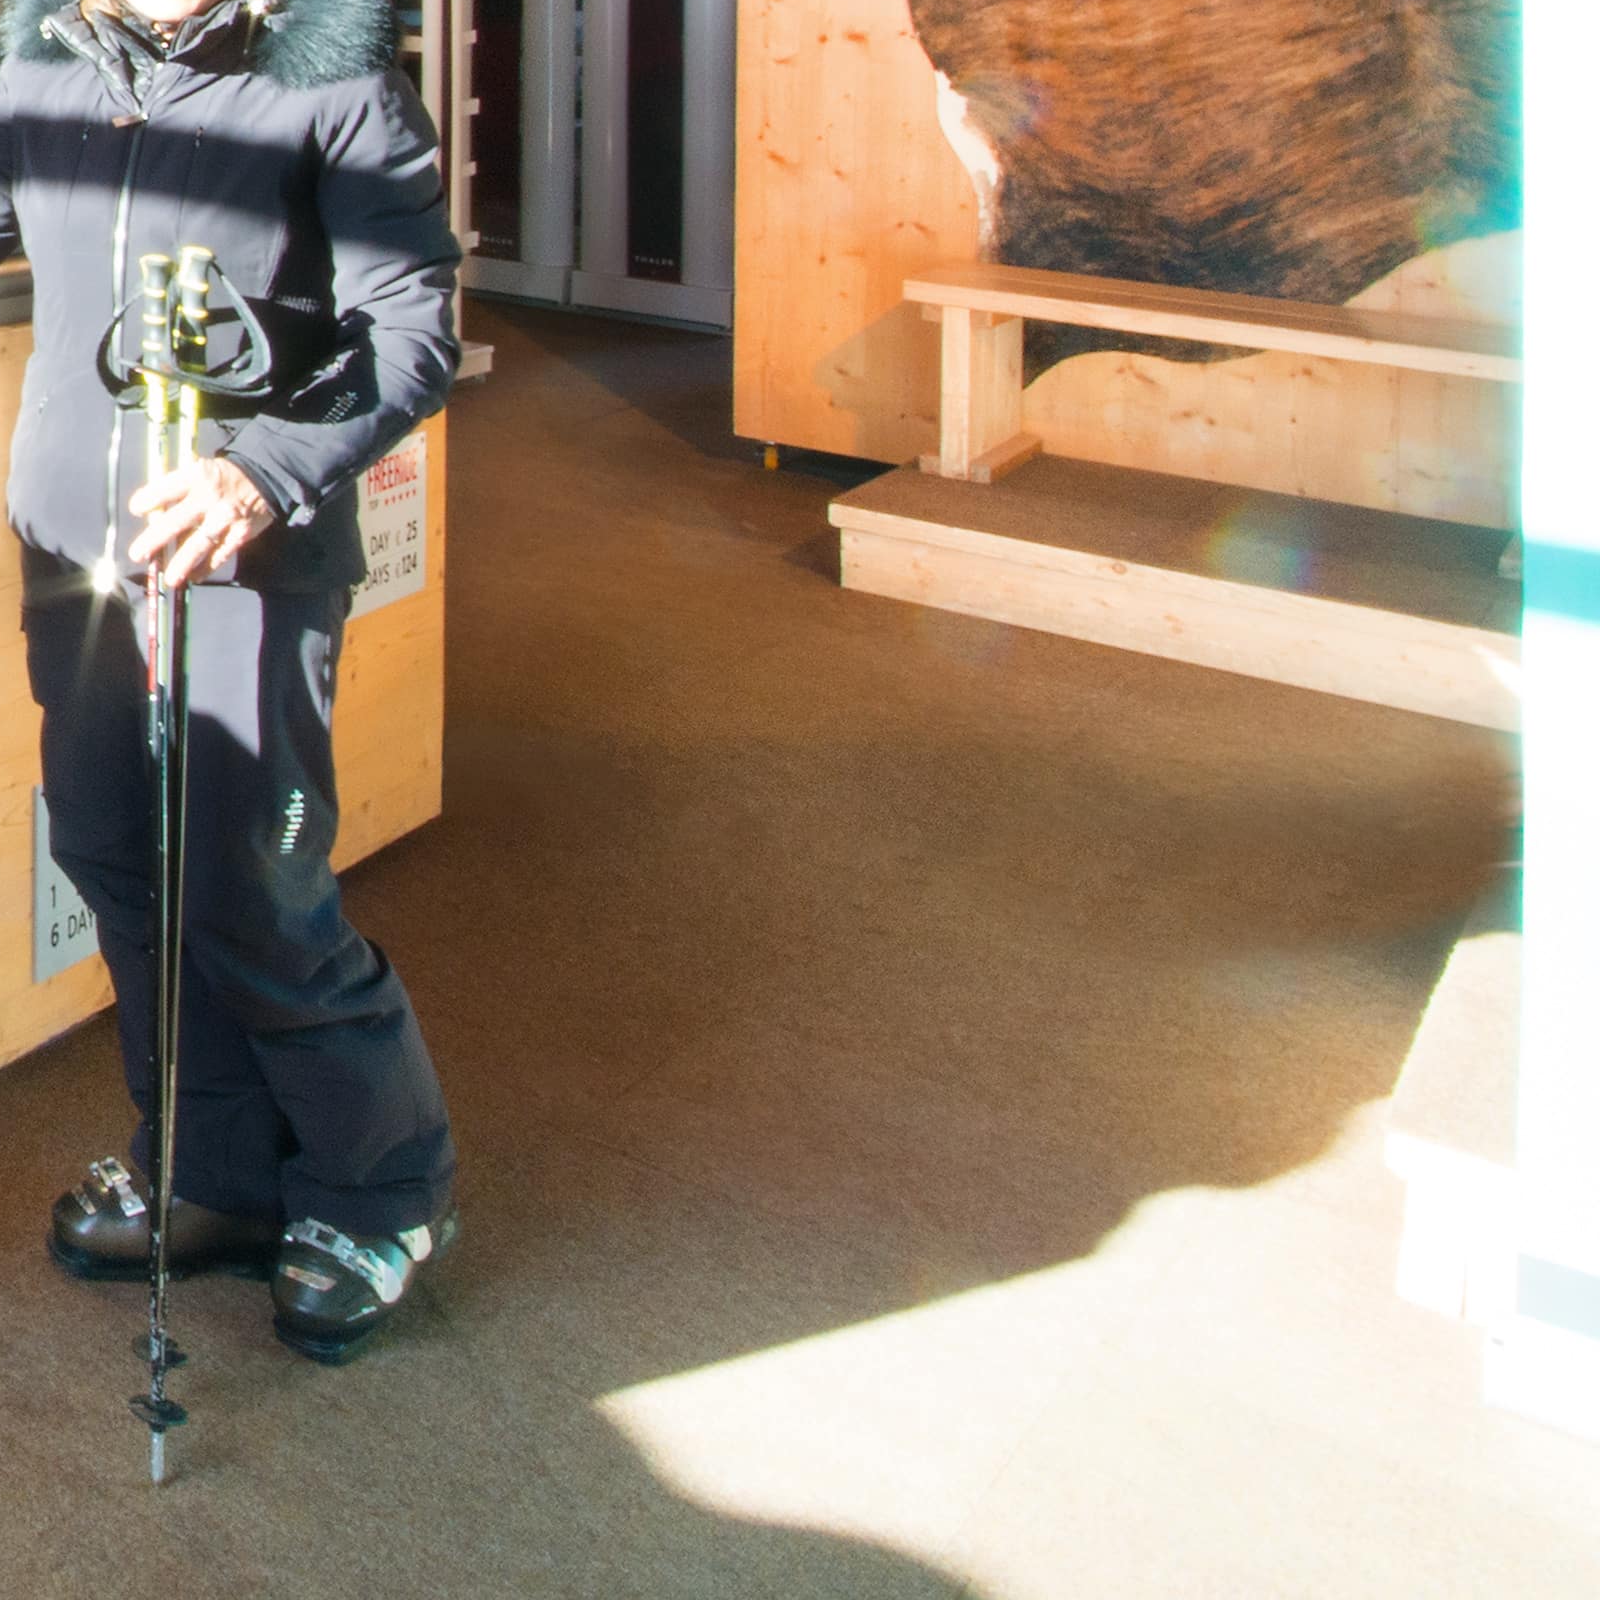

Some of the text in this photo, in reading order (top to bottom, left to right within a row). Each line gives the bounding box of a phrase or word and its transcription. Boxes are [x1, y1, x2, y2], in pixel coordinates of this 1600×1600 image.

[405, 519, 418, 542] 25
[50, 885, 57, 909] 1
[50, 907, 97, 949] 6 DAY
